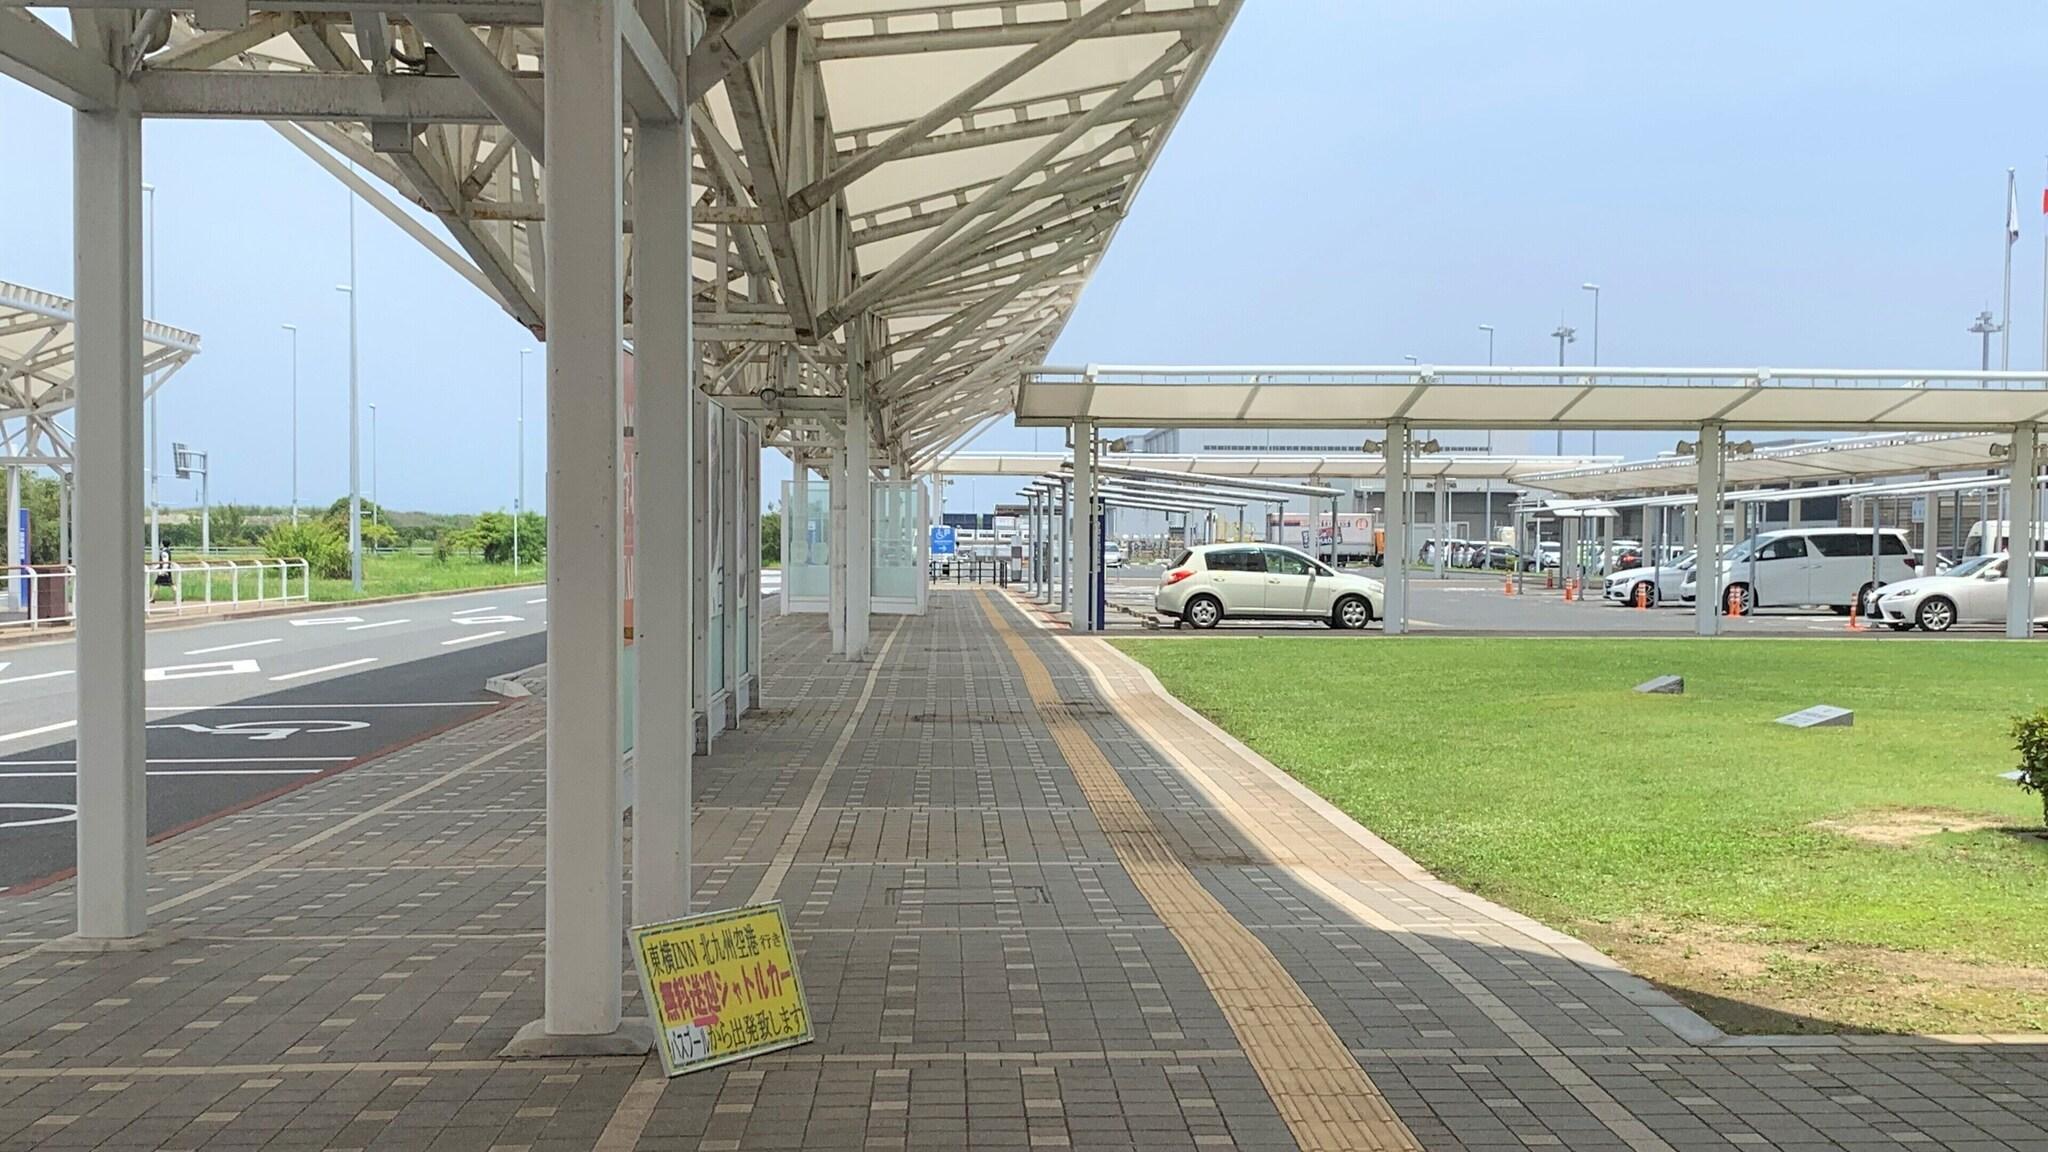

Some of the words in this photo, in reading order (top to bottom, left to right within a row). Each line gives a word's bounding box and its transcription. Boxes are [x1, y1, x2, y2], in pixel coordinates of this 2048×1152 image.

[648, 939, 699, 976] 東横INN
[700, 924, 760, 965] 北九州空港
[760, 933, 782, 950] 行き
